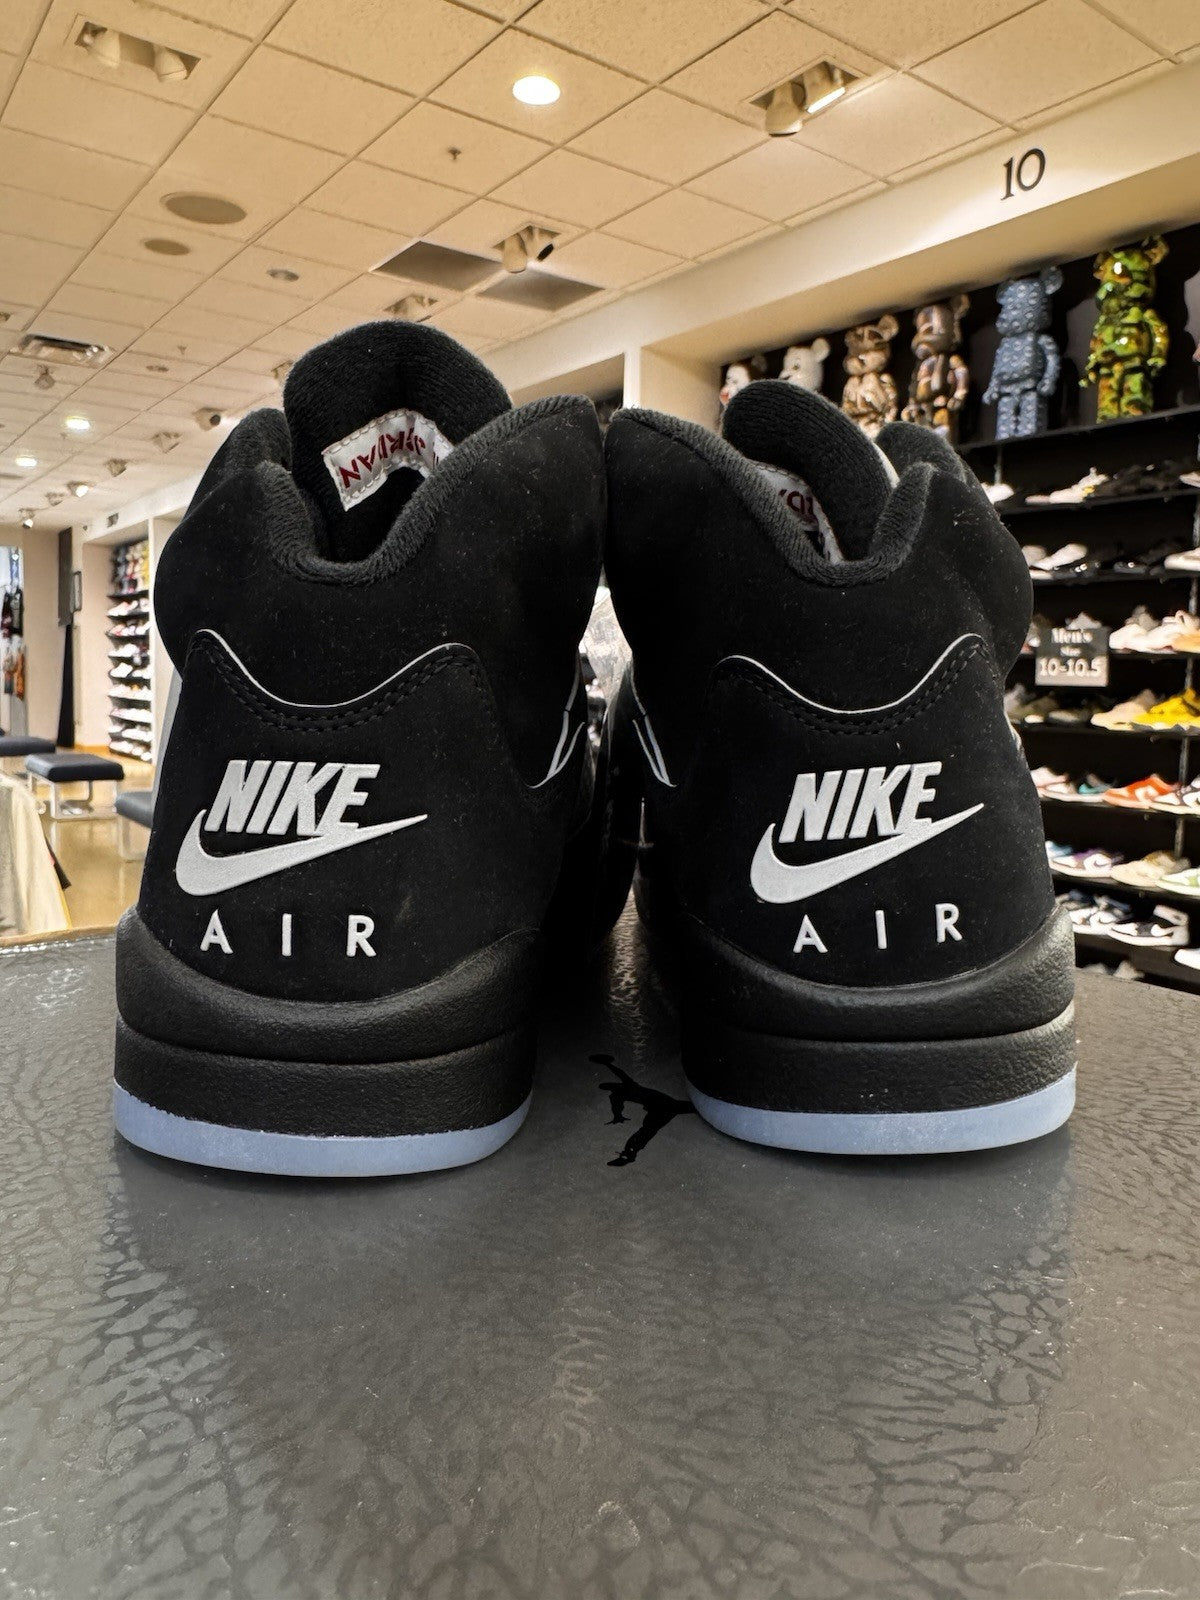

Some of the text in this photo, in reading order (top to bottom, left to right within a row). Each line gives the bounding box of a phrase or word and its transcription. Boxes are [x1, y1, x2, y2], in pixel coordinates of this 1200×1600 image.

[1000, 147, 1046, 201] 10
[1040, 657, 1102, 677] 10-10.5
[204, 759, 381, 836] NIKE
[778, 761, 943, 843] NIKE
[200, 909, 377, 957] AIR
[793, 902, 963, 954] AIR
